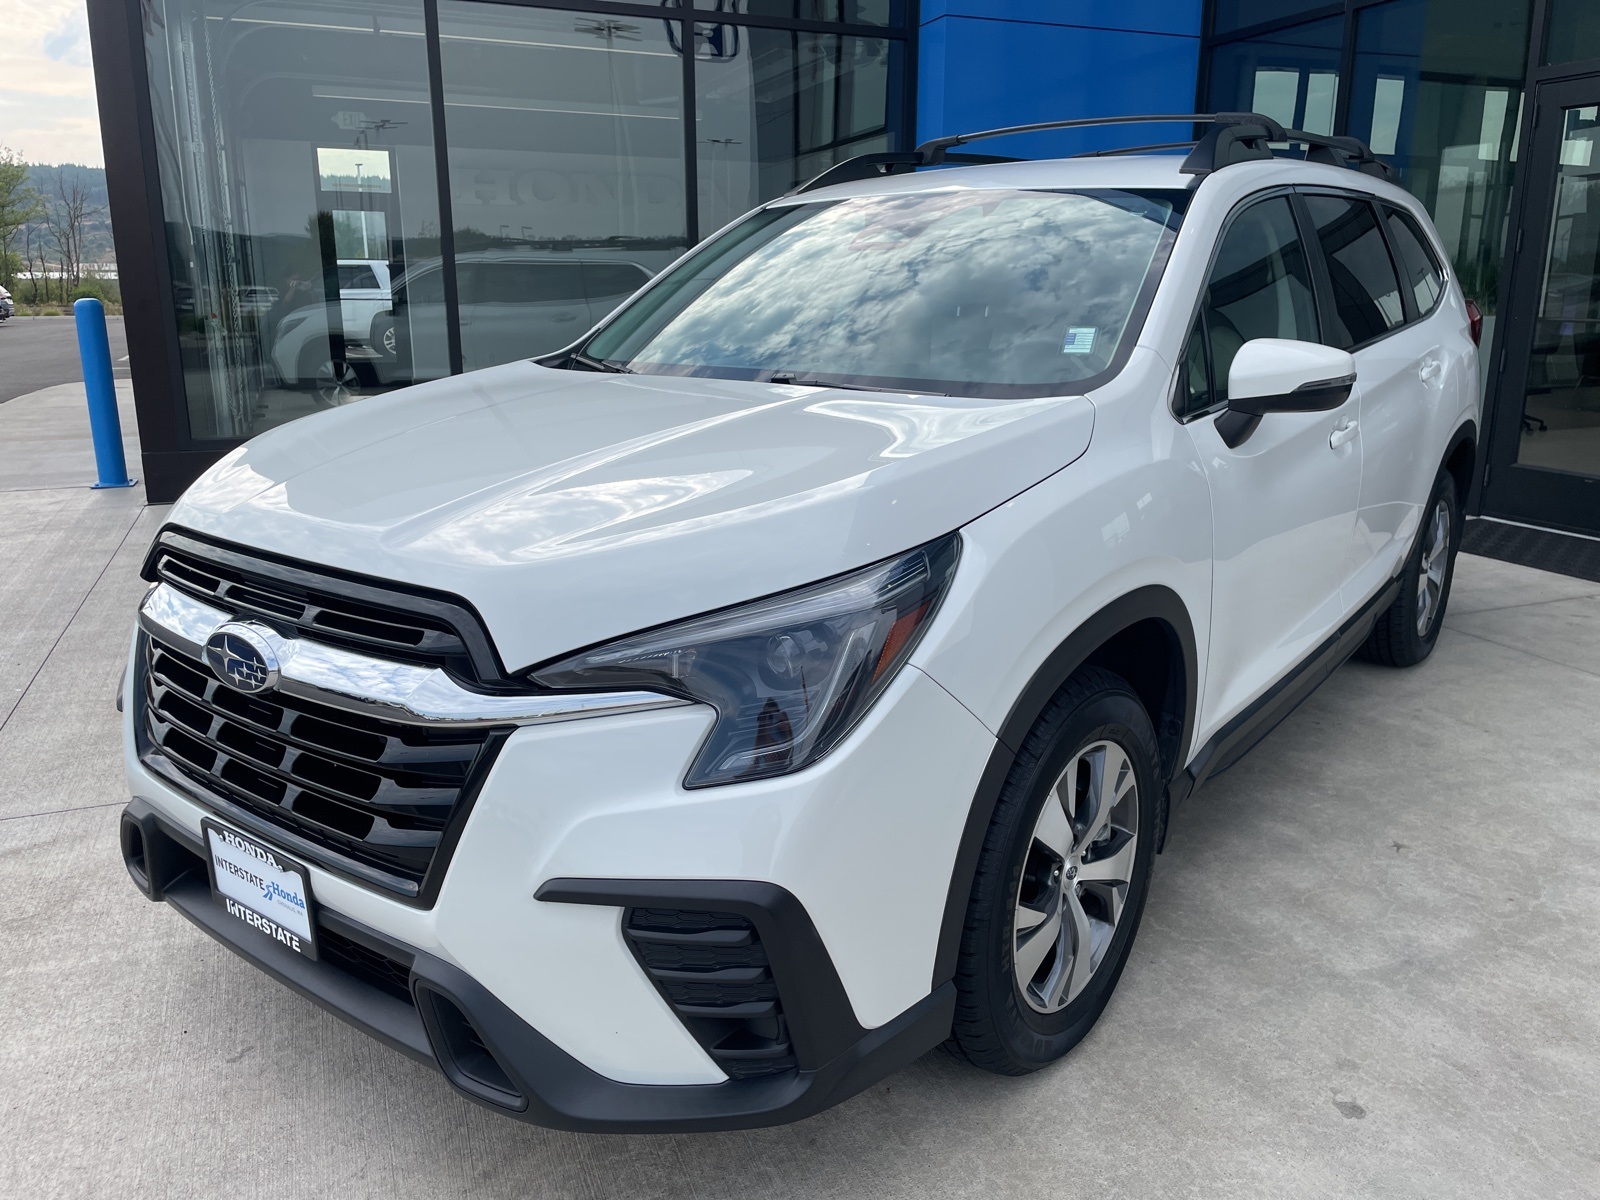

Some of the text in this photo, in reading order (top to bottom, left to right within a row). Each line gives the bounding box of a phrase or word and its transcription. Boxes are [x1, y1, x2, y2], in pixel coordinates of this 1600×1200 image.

[223, 830, 279, 867] HONDA
[214, 854, 305, 909] INTERSTATE Honda
[226, 898, 301, 953] INTERSTATE
